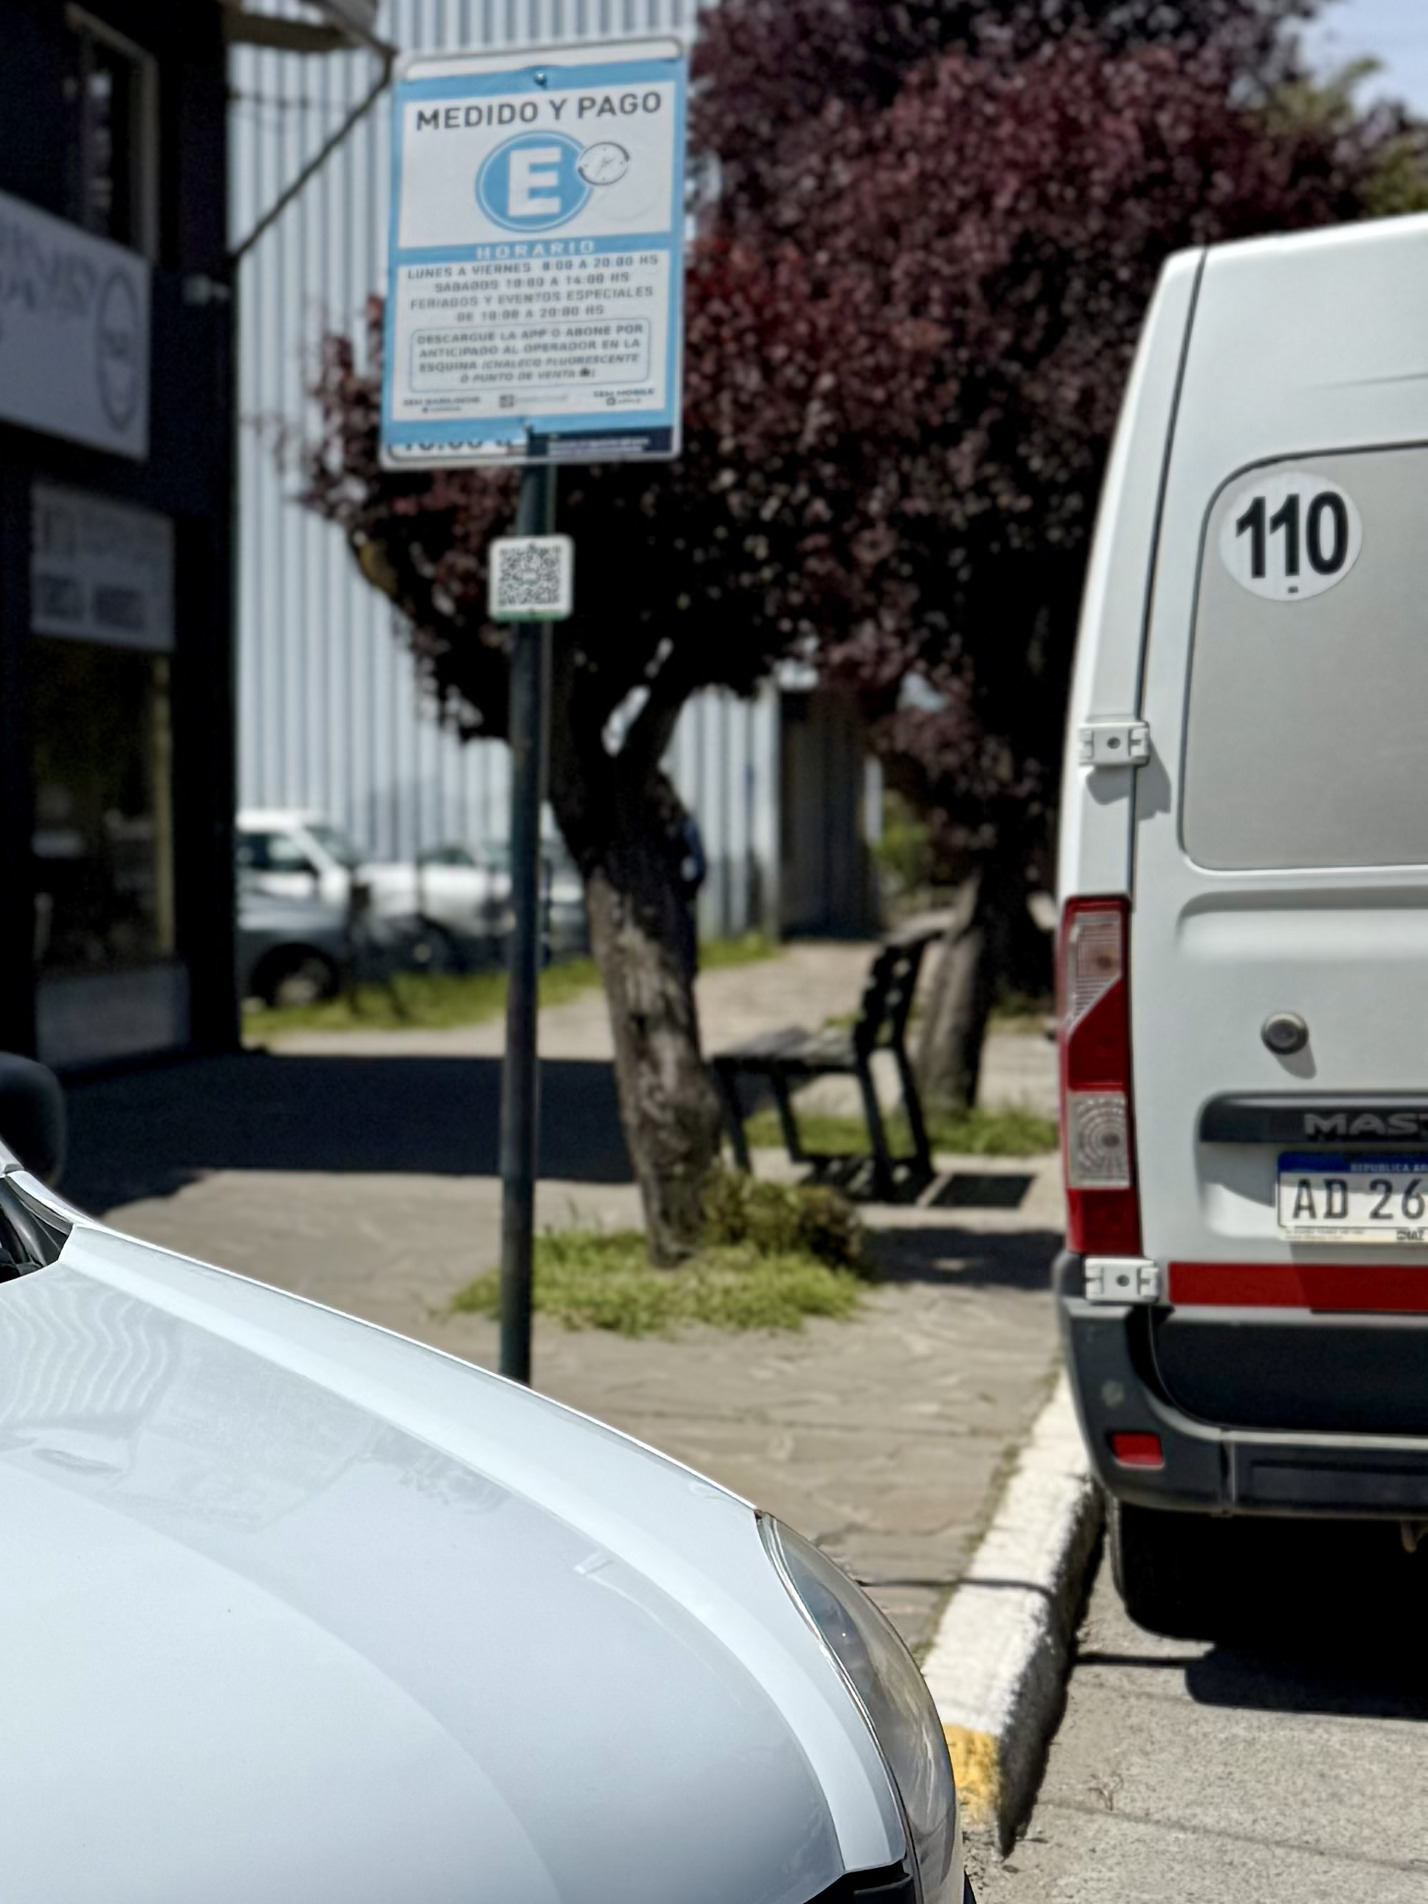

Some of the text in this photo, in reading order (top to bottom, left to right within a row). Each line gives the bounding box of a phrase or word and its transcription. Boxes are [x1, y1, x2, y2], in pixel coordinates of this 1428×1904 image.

[416, 91, 663, 132] MEDIDO Y PAGO
[507, 146, 562, 218] E
[476, 240, 594, 261] HORARIO
[408, 267, 453, 280] LUNES
[472, 262, 532, 276] VIERNES
[565, 286, 654, 301] ESPECIALES
[565, 325, 612, 337] ABONE
[616, 324, 643, 335] POR
[601, 339, 619, 350] EN
[624, 338, 641, 349] LA
[1235, 491, 1350, 580] 110
[1303, 1112, 1428, 1136] MAS
[1292, 1177, 1427, 1221] AD 26
